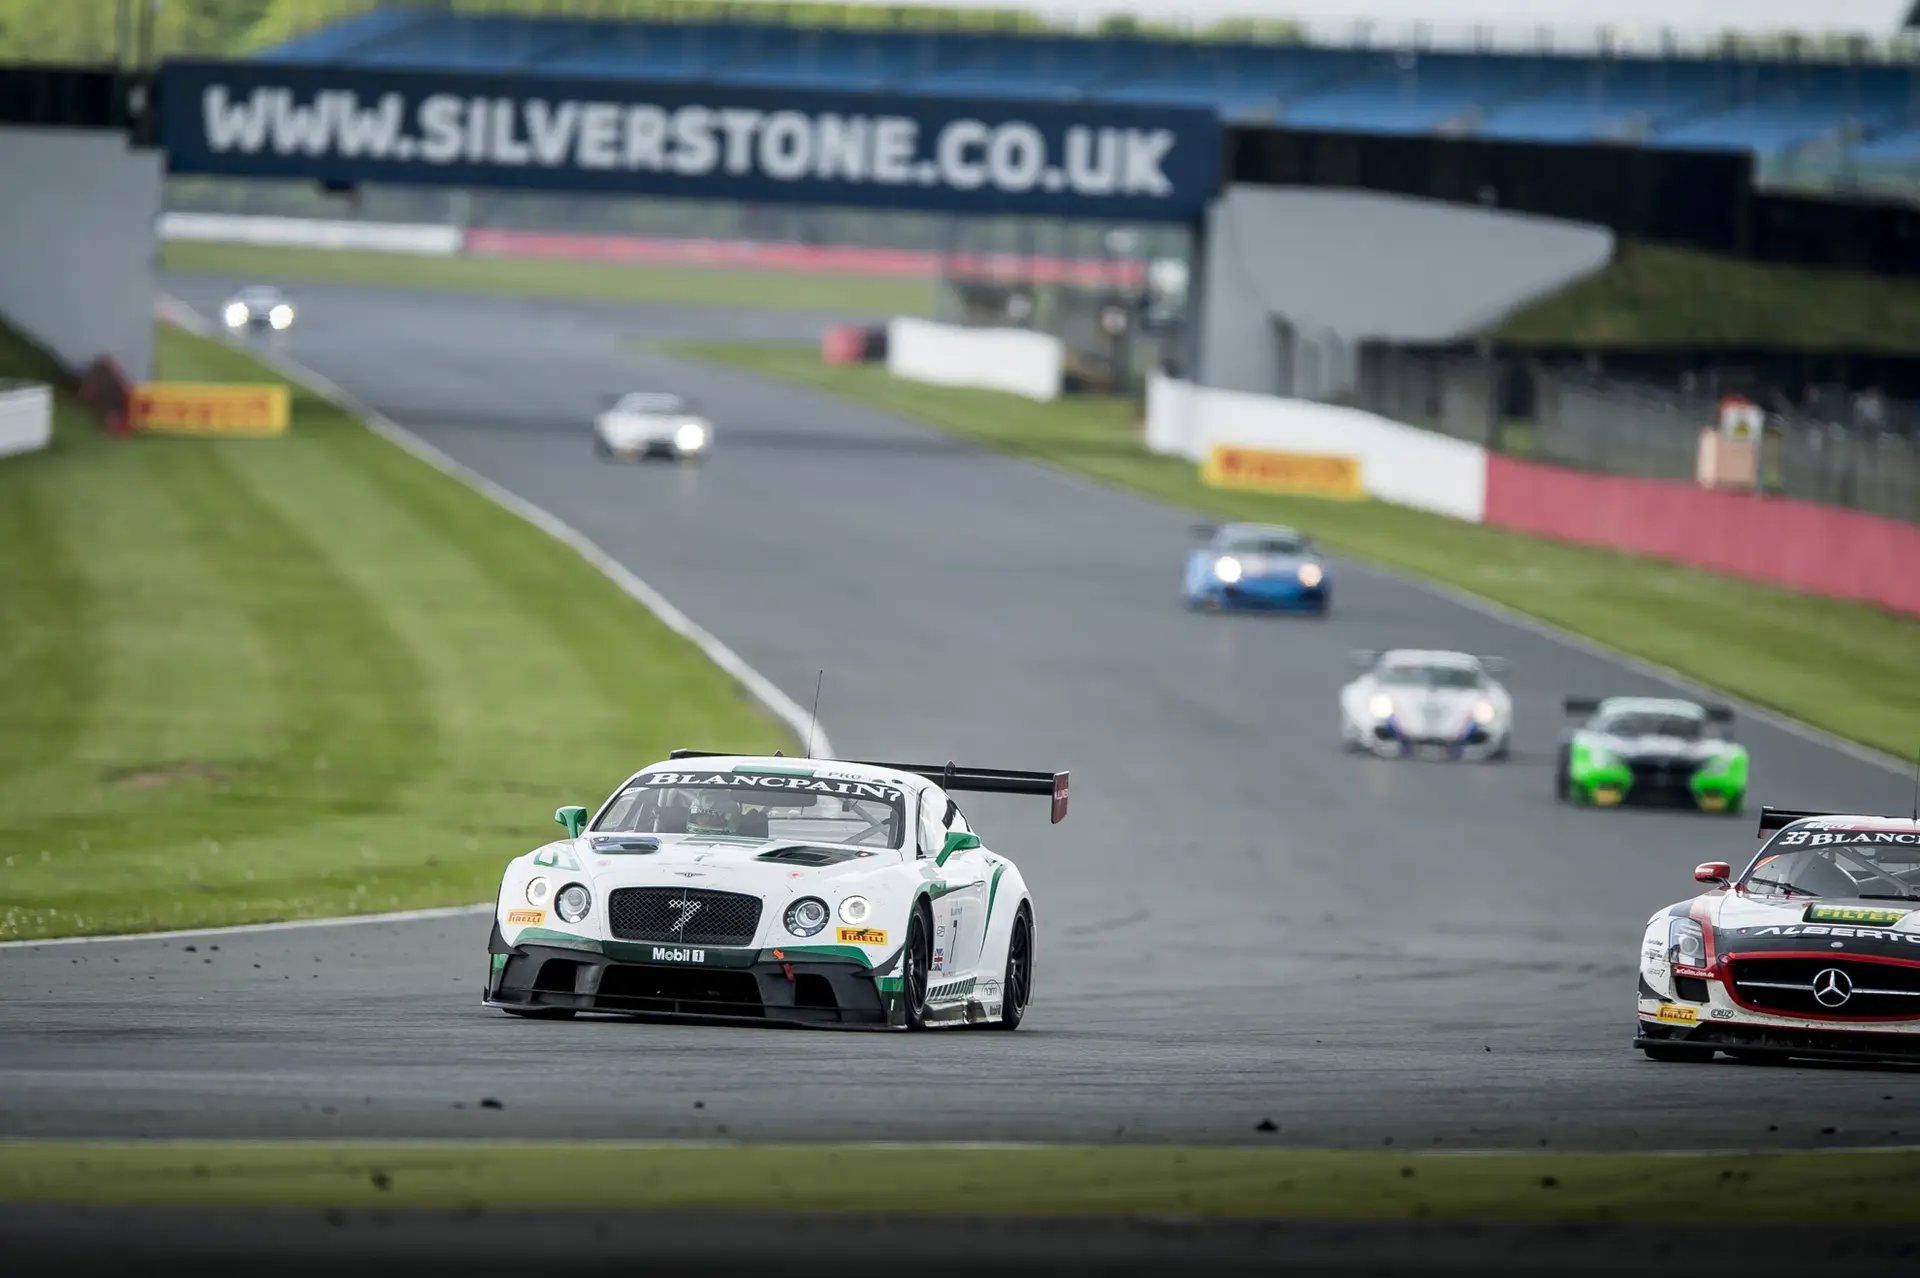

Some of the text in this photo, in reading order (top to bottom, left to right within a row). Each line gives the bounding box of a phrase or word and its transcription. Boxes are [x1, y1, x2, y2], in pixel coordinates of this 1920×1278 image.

[203, 86, 1176, 198] WWW.SILVERSTONE.CO.UK
[645, 773, 889, 799] BLANCPAIN
[1779, 831, 1920, 847] 33 BLANC
[508, 911, 542, 924] PIRELLI
[669, 899, 702, 933] 7
[1816, 909, 1906, 921] FILTER
[841, 929, 885, 944] PIRELLI
[652, 947, 690, 962] Mobil
[1660, 1007, 1694, 1021] PIRELLI
[1713, 1010, 1733, 1019] CRUZ
